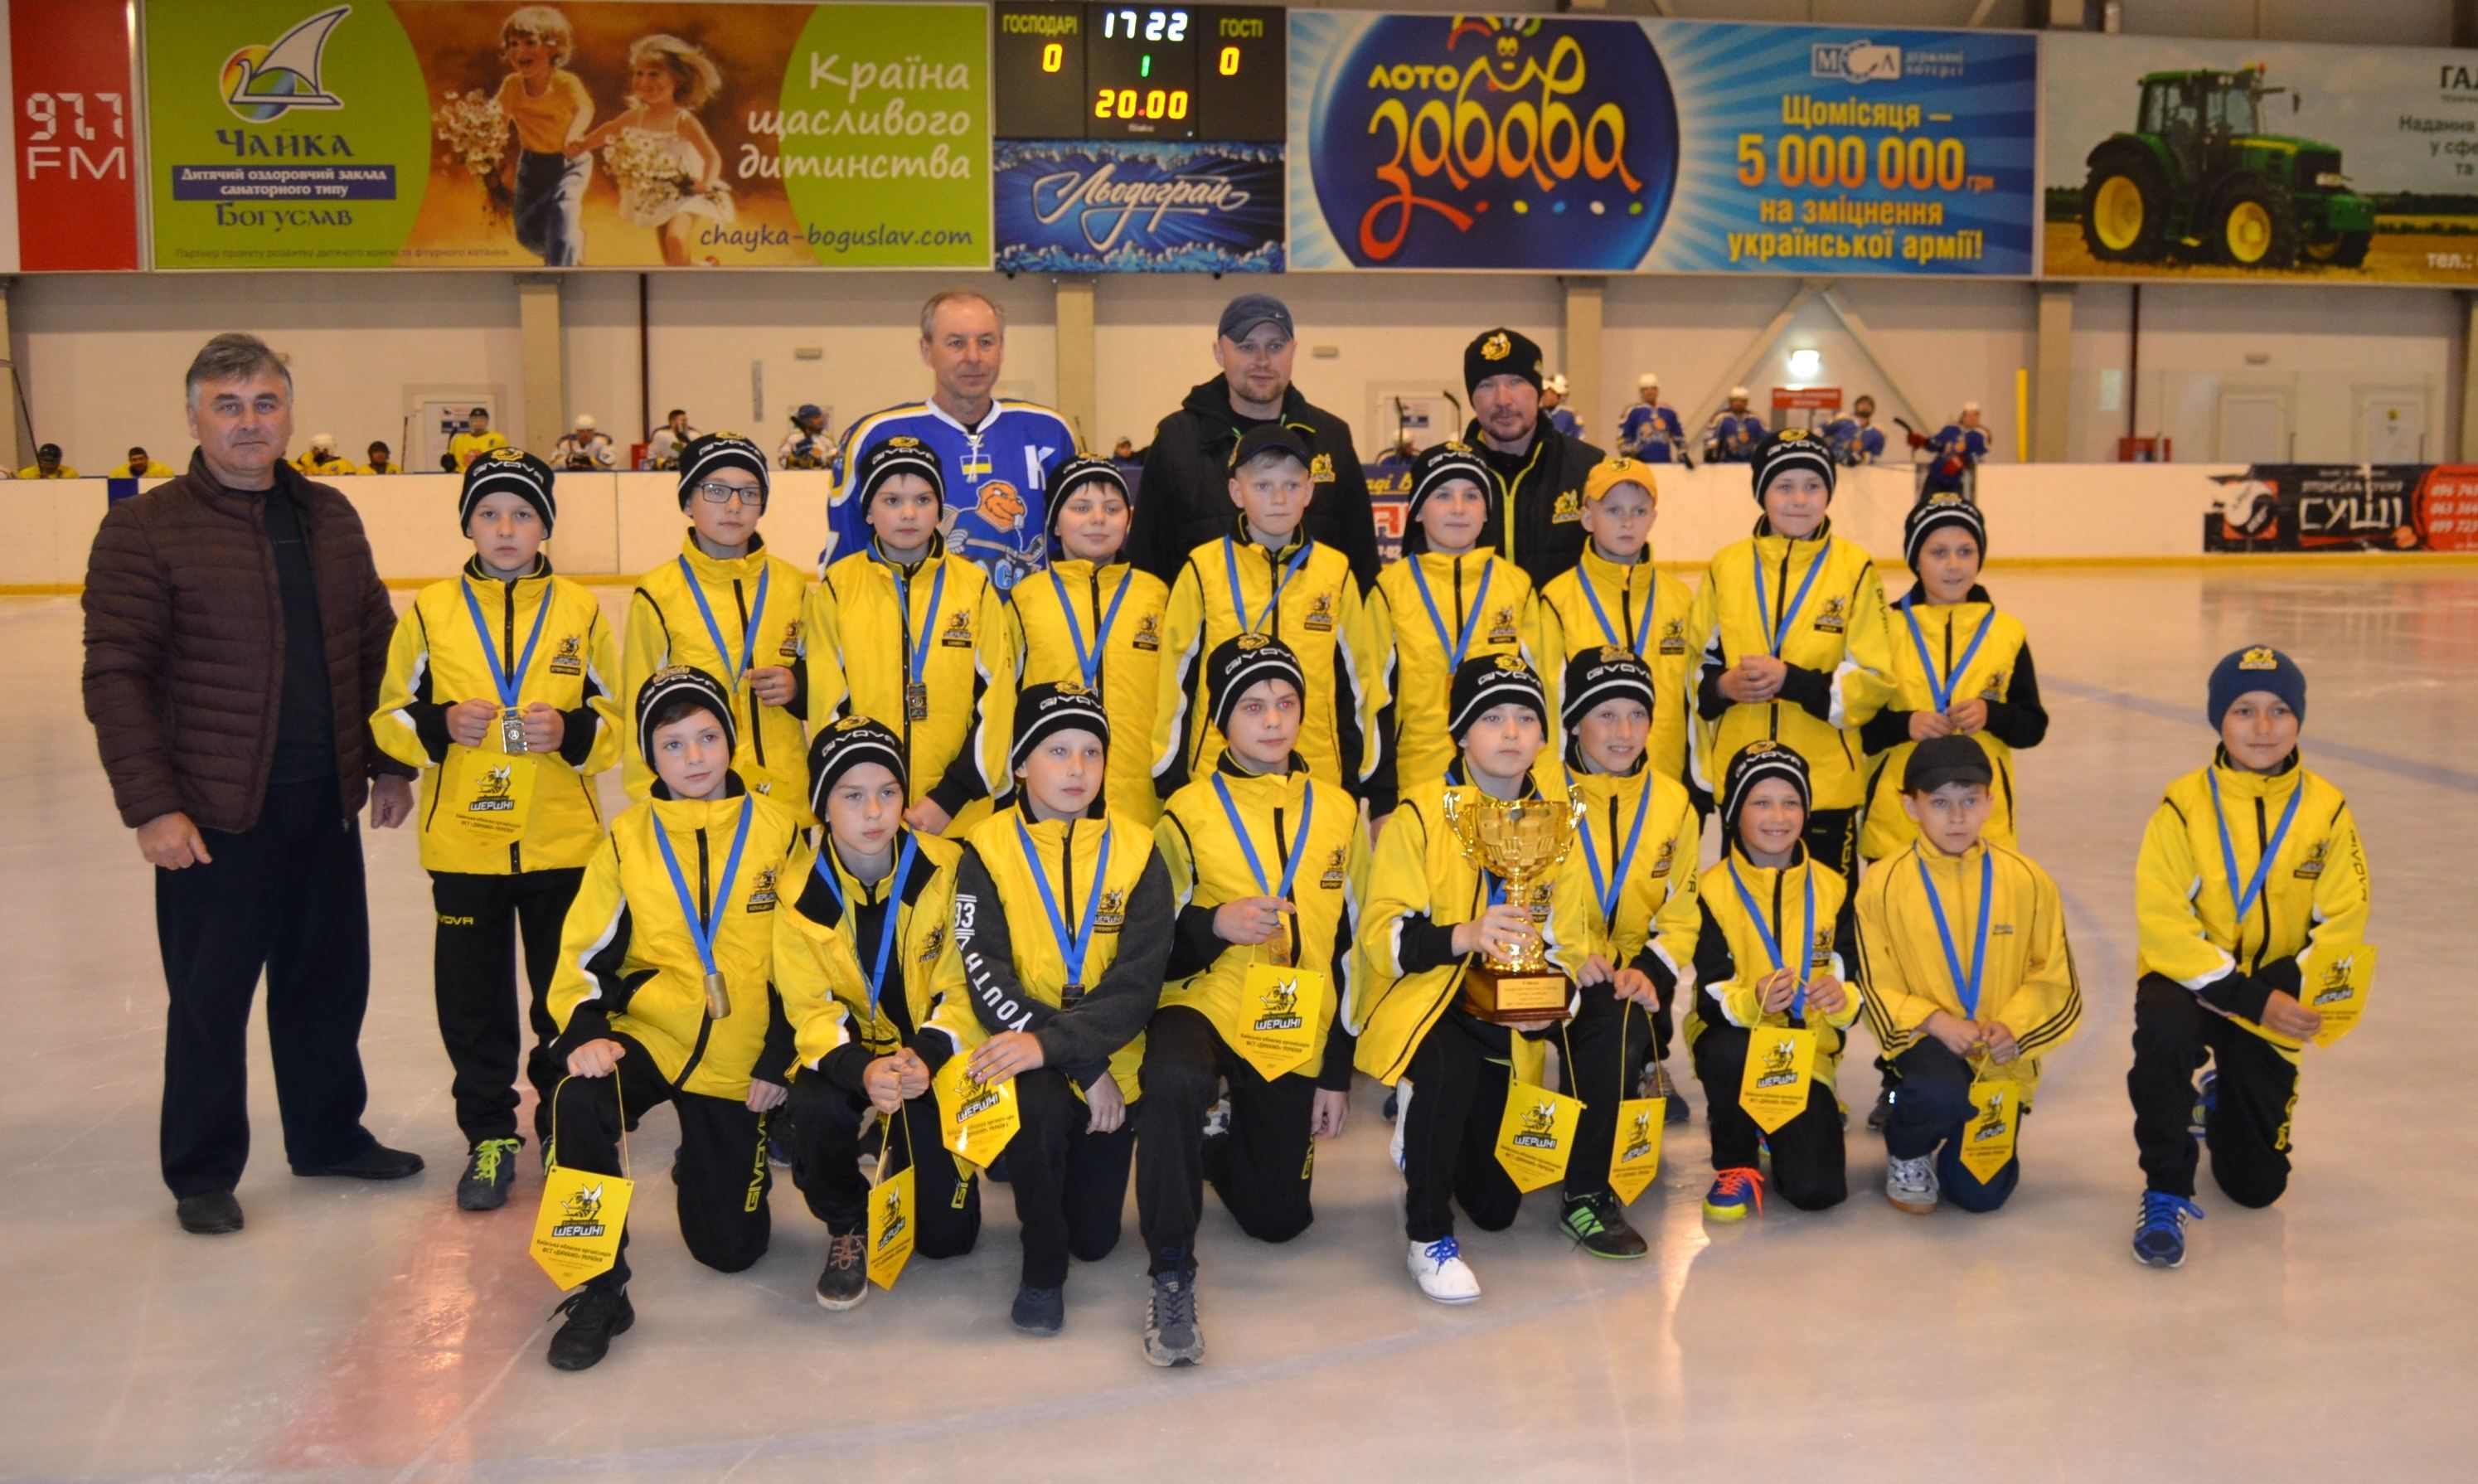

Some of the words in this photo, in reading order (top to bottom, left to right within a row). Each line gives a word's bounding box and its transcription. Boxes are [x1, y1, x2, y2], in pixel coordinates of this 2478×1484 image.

[1002, 14, 1078, 36] ГОСПОДАРІ
[1220, 18, 1264, 38] ГОСТІ
[1042, 43, 1063, 73] 0
[1141, 55, 1151, 77] 1
[1220, 46, 1240, 75] 0
[809, 51, 970, 104] Країна
[27, 92, 124, 141] 97.7
[747, 97, 971, 142] щасливого
[1782, 95, 1921, 131] Щомісяця
[27, 148, 126, 180] FM
[181, 167, 245, 181] Дитячий
[248, 167, 335, 182] оздоровчий
[338, 169, 387, 181] заклад
[738, 143, 971, 179] дитинства
[1738, 133, 1766, 187] 5
[1777, 133, 1865, 189] 000
[1877, 136, 1965, 191] 000
[221, 185, 312, 198] санаторного
[315, 185, 349, 198] типу
[1760, 199, 1793, 223] на
[1802, 195, 1943, 228] зміцнення
[701, 222, 972, 253] chayka-boguslav.com
[1727, 227, 1894, 263] української
[1902, 229, 1983, 266] армії!
[2299, 497, 2403, 531] СУШІ
[965, 953, 1033, 1034] YOUTH
[1255, 1018, 1301, 1030] ШЕРШНІ
[958, 1094, 998, 1123] ШЕРШНІ
[1515, 1136, 1556, 1148] ШЕРШНІ
[553, 1225, 604, 1236] ШЕРШНІ
